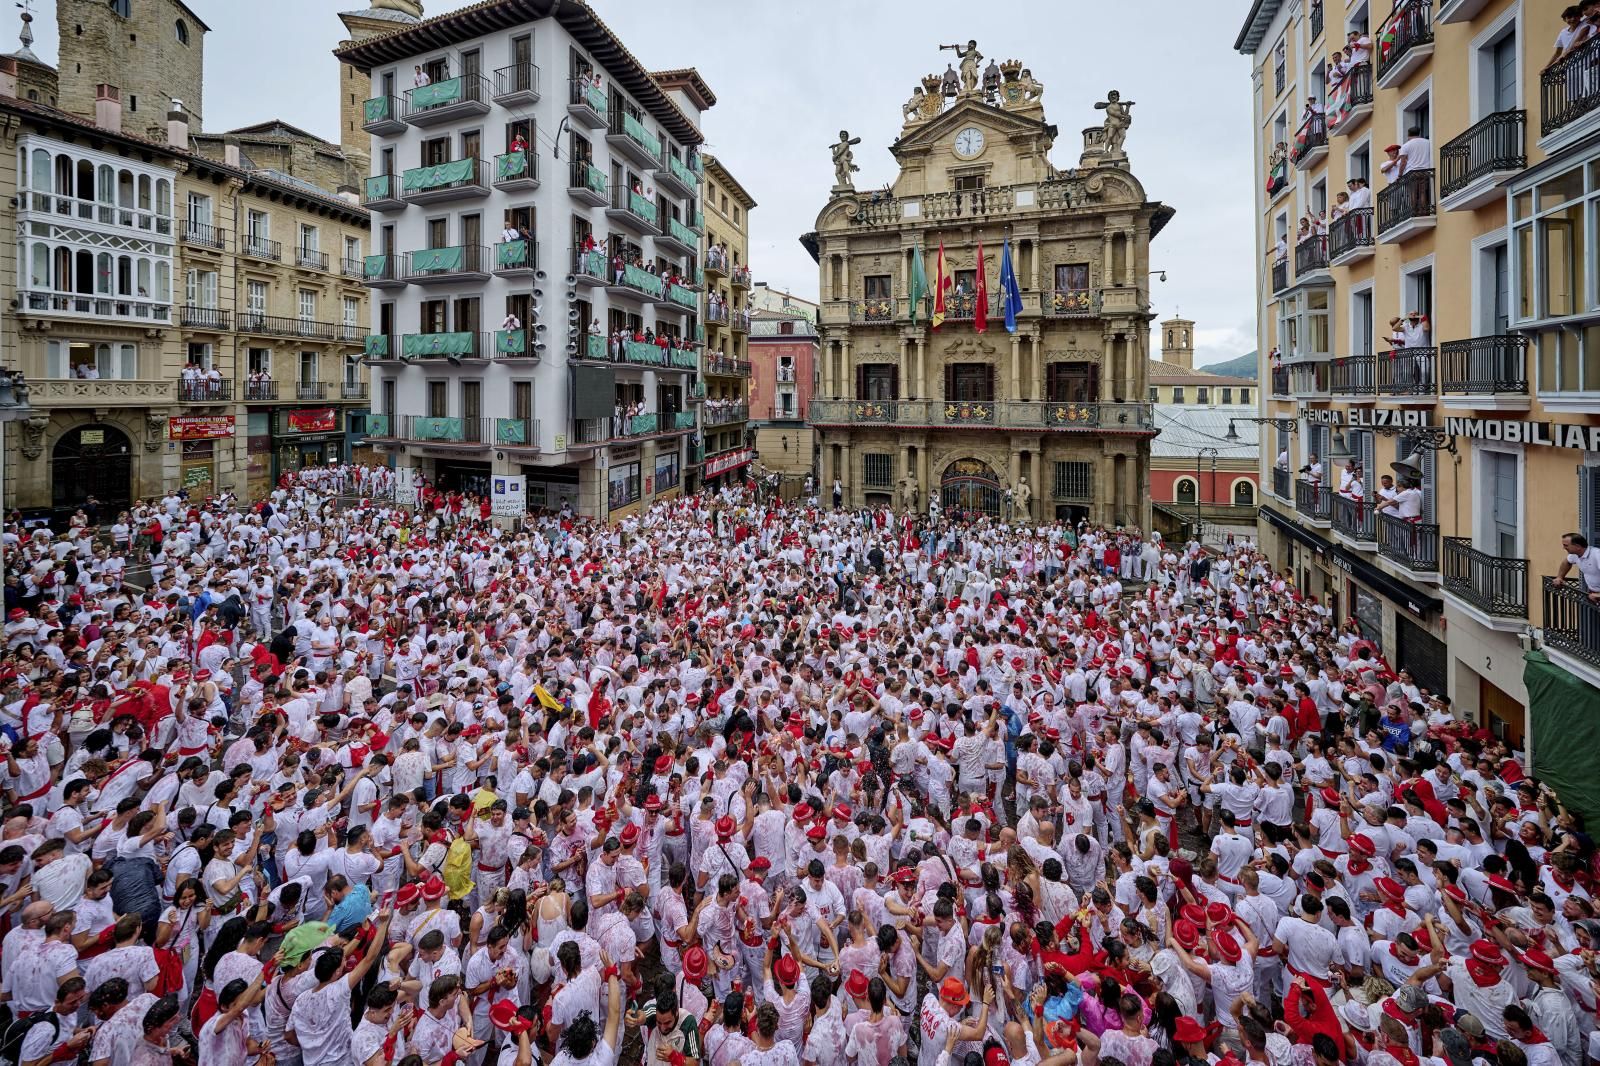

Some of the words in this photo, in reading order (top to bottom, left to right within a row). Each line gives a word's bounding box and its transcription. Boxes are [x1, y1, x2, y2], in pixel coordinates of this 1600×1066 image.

[1297, 407, 1341, 425] AGENCIA
[1347, 407, 1428, 427] ELIZARI
[1333, 555, 1342, 568] BAR
[1486, 656, 1493, 671] 2
